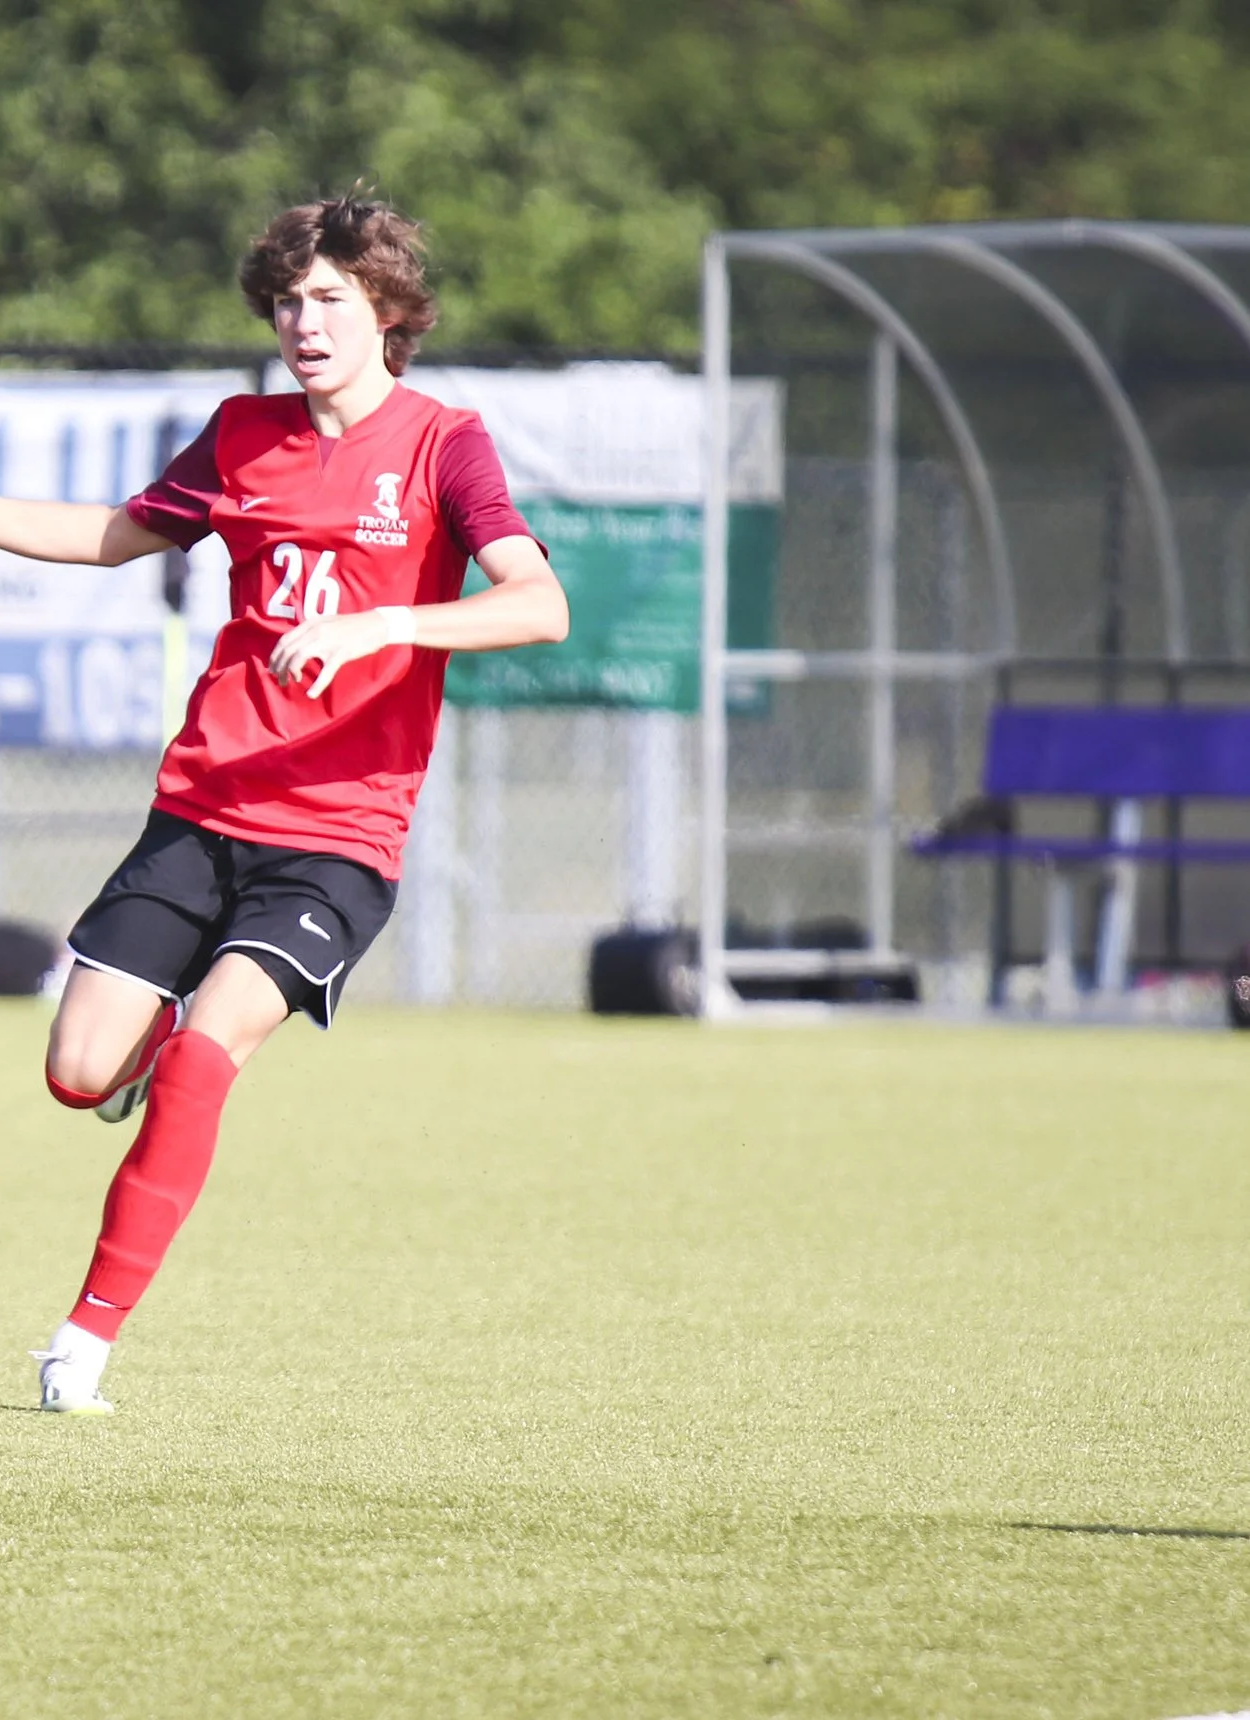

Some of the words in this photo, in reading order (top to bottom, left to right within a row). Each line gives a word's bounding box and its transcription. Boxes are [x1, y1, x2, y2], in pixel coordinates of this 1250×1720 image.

[357, 515, 409, 531] TROJAN
[354, 528, 408, 547] SOCCER
[266, 542, 341, 620] 26
